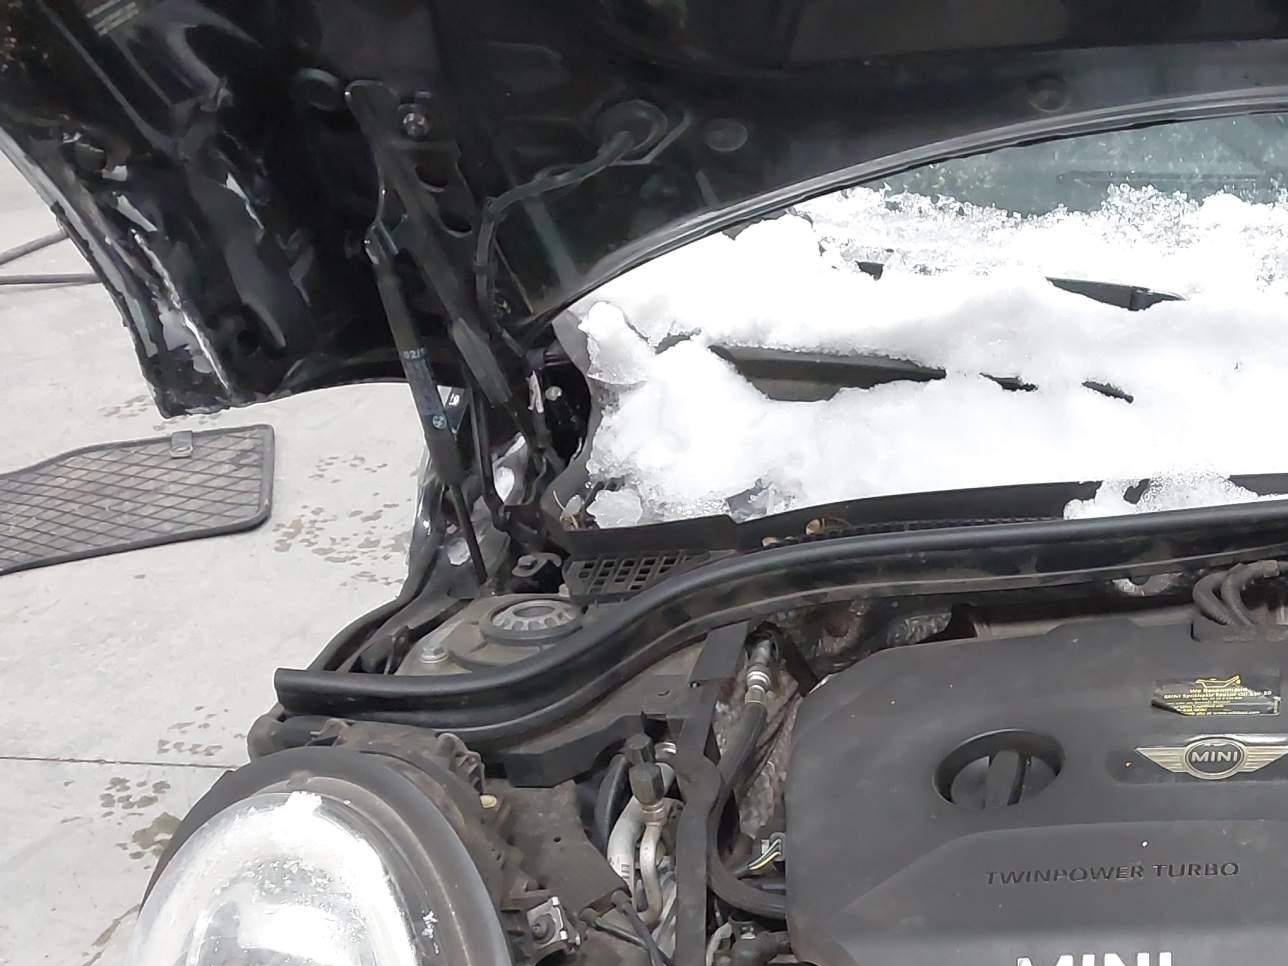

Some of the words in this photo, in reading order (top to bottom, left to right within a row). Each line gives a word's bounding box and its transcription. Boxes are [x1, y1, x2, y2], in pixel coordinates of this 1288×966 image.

[1191, 751, 1238, 763] MINI
[986, 865, 1145, 885] TWINPOWER
[1152, 862, 1240, 878] TURBO
